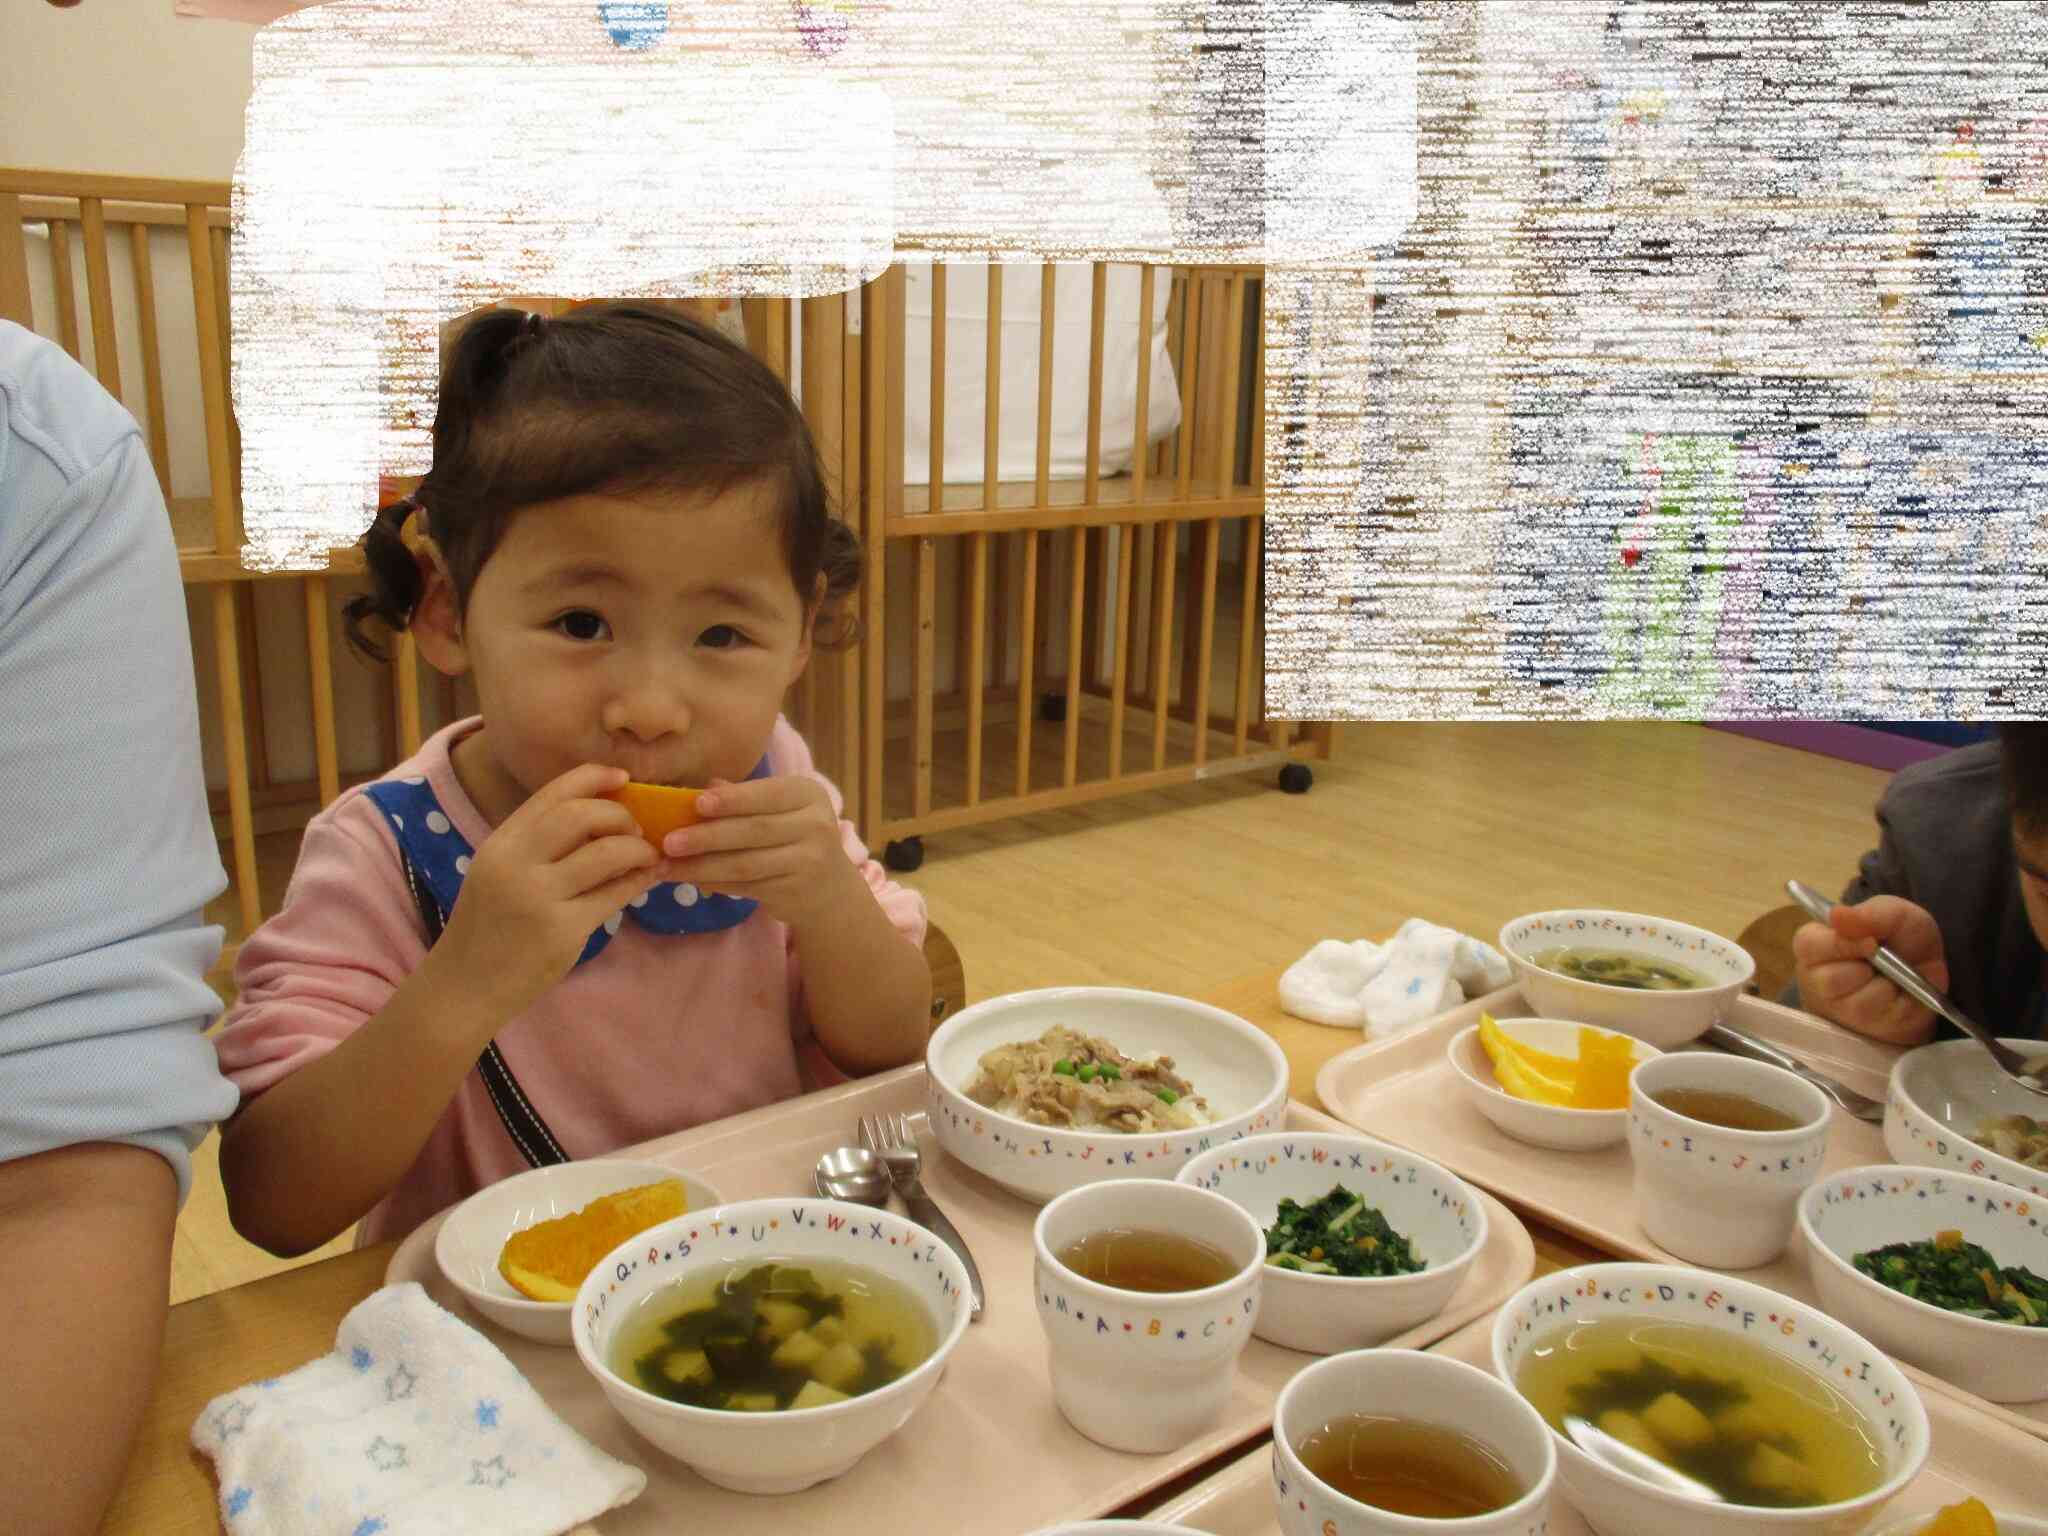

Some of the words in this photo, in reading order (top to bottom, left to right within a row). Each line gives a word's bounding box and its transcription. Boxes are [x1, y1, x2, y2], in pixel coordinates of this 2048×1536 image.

[1043, 1139, 1053, 1154] I
[1080, 1146, 1094, 1160] J
[1124, 1151, 1136, 1165] K
[1683, 1138, 1692, 1152] I
[1732, 1155, 1747, 1169] J
[1780, 1158, 1790, 1171] K
[1937, 1141, 1947, 1155] D
[1970, 1159, 1984, 1174] E
[1255, 1159, 1267, 1174] U
[1283, 1144, 1294, 1159] V
[1312, 1147, 1328, 1164] W
[1349, 1153, 1362, 1169] X
[1408, 1168, 1417, 1183] Z
[1440, 1193, 1449, 1208] A
[1871, 1179, 1885, 1196] X
[1984, 1198, 1999, 1215] A
[2016, 1201, 2030, 1217] B
[616, 1263, 631, 1281] Q
[647, 1248, 659, 1265] R
[678, 1240, 691, 1257] S
[709, 1222, 721, 1237] T
[751, 1225, 764, 1242] U
[793, 1207, 803, 1224] V
[827, 1214, 846, 1232] W
[870, 1222, 882, 1240] X
[903, 1231, 914, 1245] Y
[926, 1245, 937, 1262] Z
[1056, 1295, 1068, 1314] M
[1097, 1316, 1110, 1334] A
[1148, 1317, 1161, 1336] B
[1203, 1320, 1216, 1337] C
[1560, 1295, 1571, 1312] A
[1586, 1279, 1597, 1296] B
[1618, 1287, 1631, 1303] C
[1658, 1285, 1674, 1301] D
[1705, 1289, 1722, 1311] E
[1743, 1311, 1756, 1329] F
[1780, 1318, 1796, 1336] G
[1818, 1347, 1837, 1367] H
[1858, 1361, 1871, 1380] I
